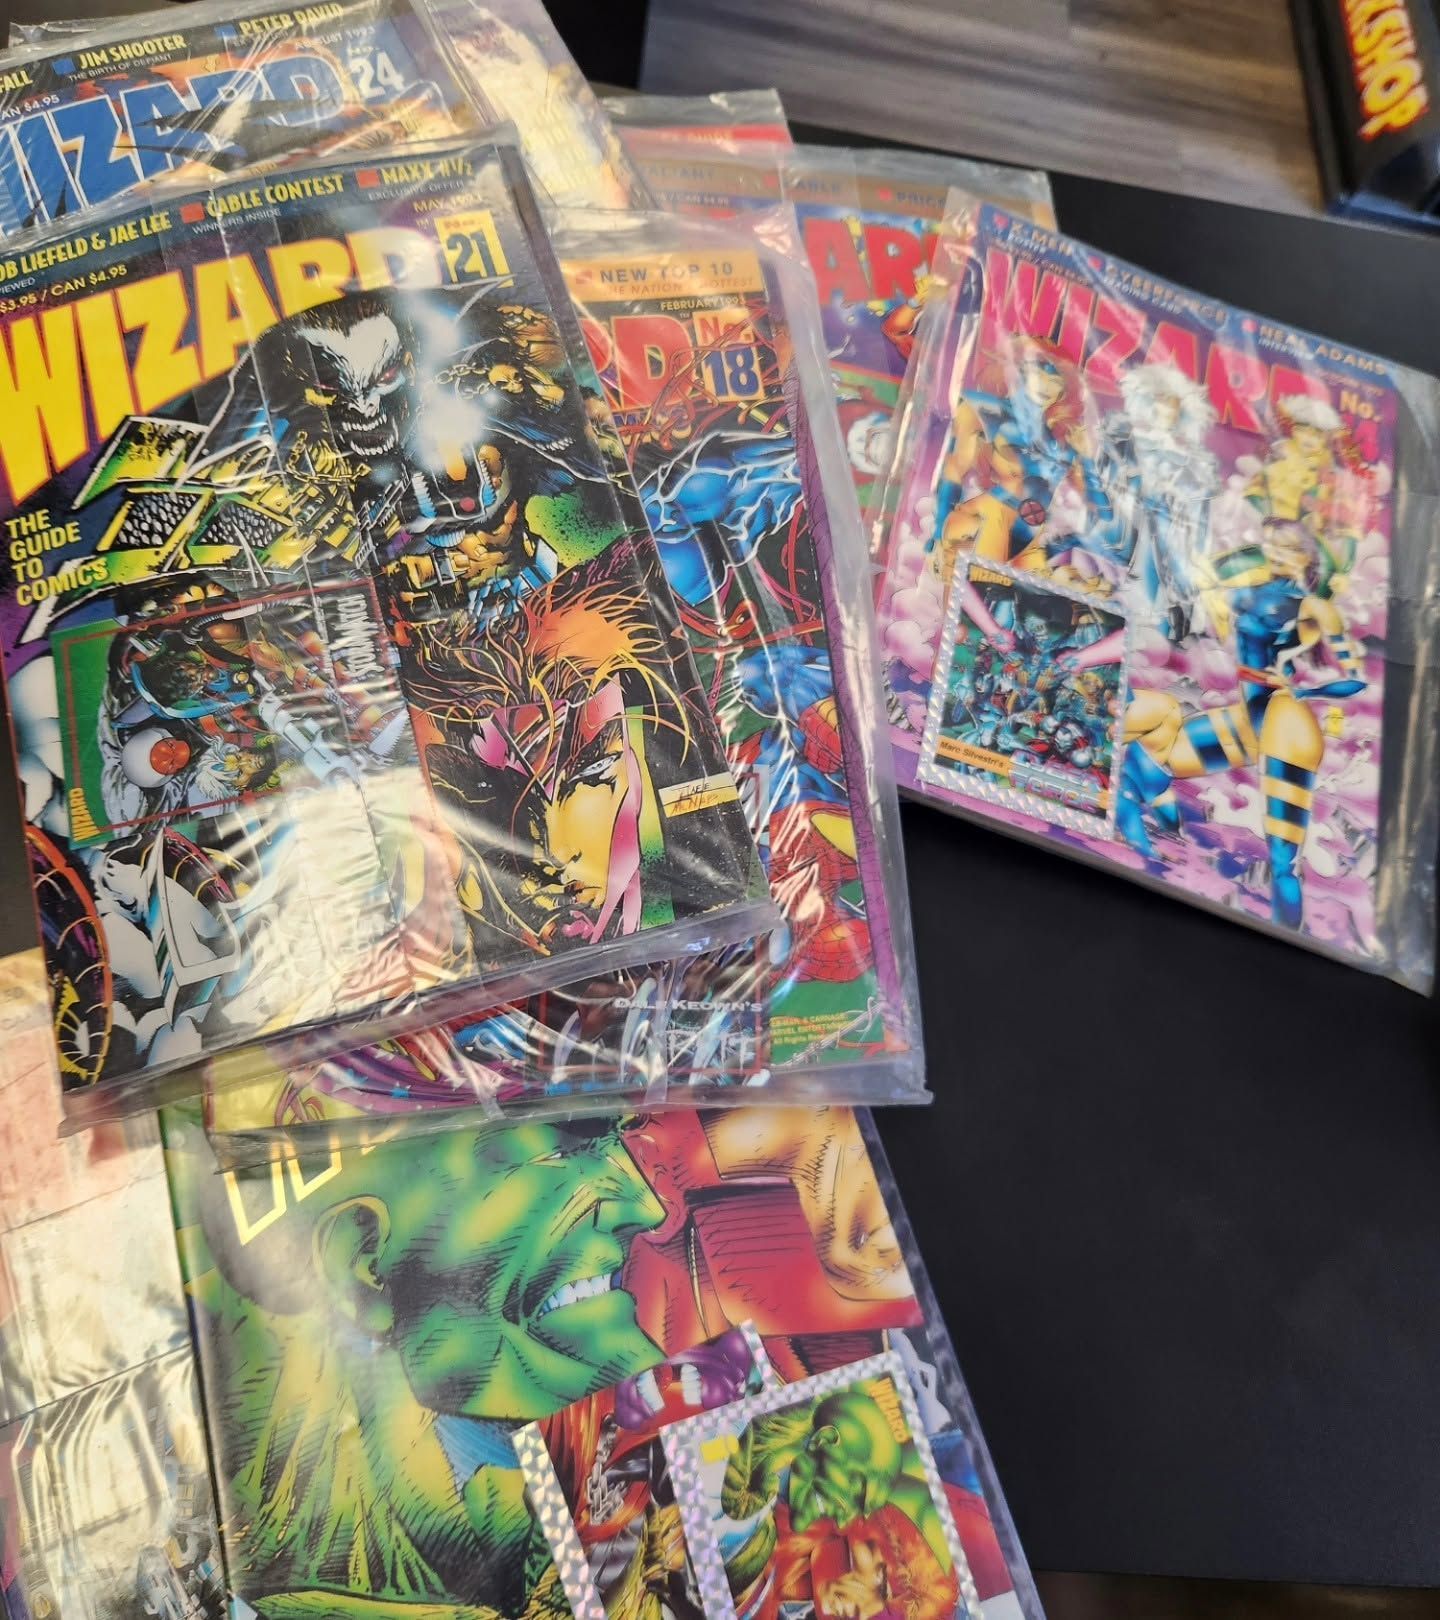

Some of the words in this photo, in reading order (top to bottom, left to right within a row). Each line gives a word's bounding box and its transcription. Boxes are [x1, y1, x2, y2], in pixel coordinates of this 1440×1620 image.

[0, 71, 33, 93] FALL
[79, 52, 109, 69] JIM
[113, 35, 188, 63] SHOOTER
[239, 13, 294, 36] PETER
[293, 3, 343, 24] DAVID
[69, 72, 89, 82] THE
[90, 65, 117, 78] BIRTH
[119, 62, 132, 71] OF
[350, 52, 405, 99] 24
[25, 95, 60, 112] $4.95
[0, 56, 345, 238] IZARD
[21, 237, 88, 274] LIEFELD
[91, 232, 106, 251] &
[109, 220, 139, 246] JAE
[140, 211, 172, 236] LEE
[206, 188, 263, 217] CABLE
[264, 174, 344, 204] CONTEST
[381, 161, 433, 185] MAXX
[413, 198, 444, 213] MAY
[447, 228, 498, 283] 21
[601, 269, 647, 283] NEW
[660, 264, 700, 279] TOP
[711, 262, 733, 276] 10
[0, 292, 37, 314] $3.95
[51, 277, 86, 297] CAN
[89, 265, 127, 286] $4.95
[660, 297, 717, 312] FEBRUARY
[0, 228, 443, 506] WIZARD
[704, 349, 760, 397] 18
[1316, 344, 1387, 375] ADAMS
[1340, 390, 1382, 422] No.
[6, 510, 50, 539] THE
[9, 522, 81, 562] GUIDE
[12, 558, 44, 584] TO
[16, 561, 109, 607] COMICS
[940, 741, 961, 753] Marc
[964, 746, 1005, 769] Silvestri's
[69, 788, 100, 841] WIZARD
[673, 999, 763, 1012] KEOWN'S
[869, 1377, 910, 1444] WIZARD
